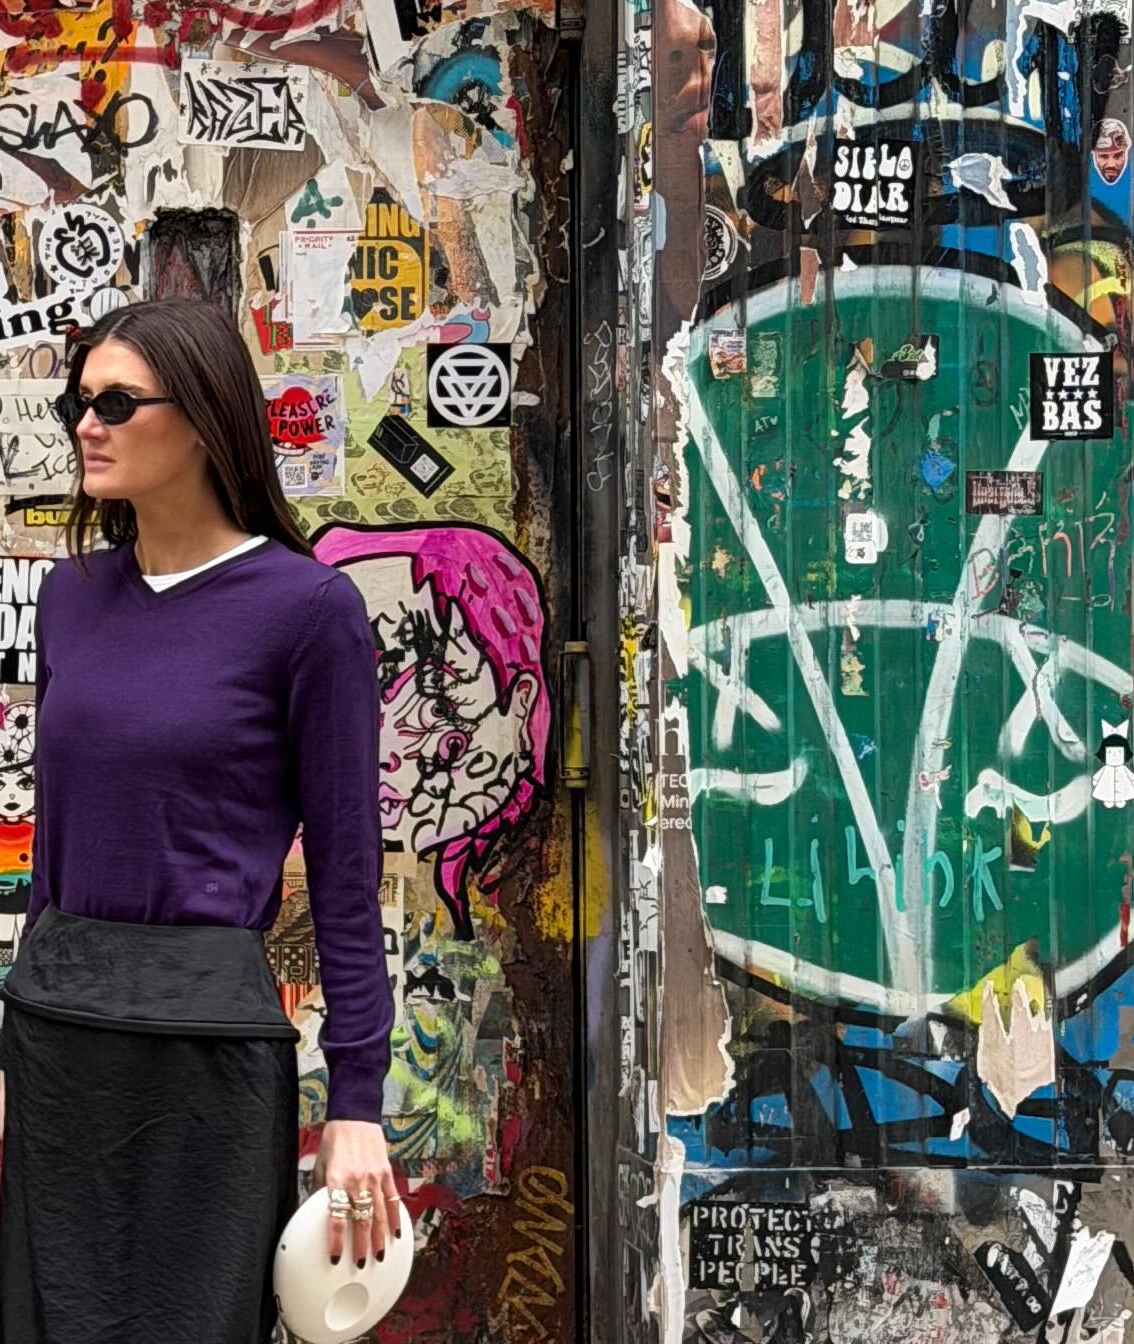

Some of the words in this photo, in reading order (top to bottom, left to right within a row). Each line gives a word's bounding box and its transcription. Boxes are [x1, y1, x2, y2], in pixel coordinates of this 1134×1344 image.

[1042, 356, 1101, 387] VEZ
[278, 414, 336, 437] POWER
[1041, 399, 1103, 432] BAS
[692, 1205, 812, 1234] PROTECT
[707, 1234, 802, 1260] TRANS
